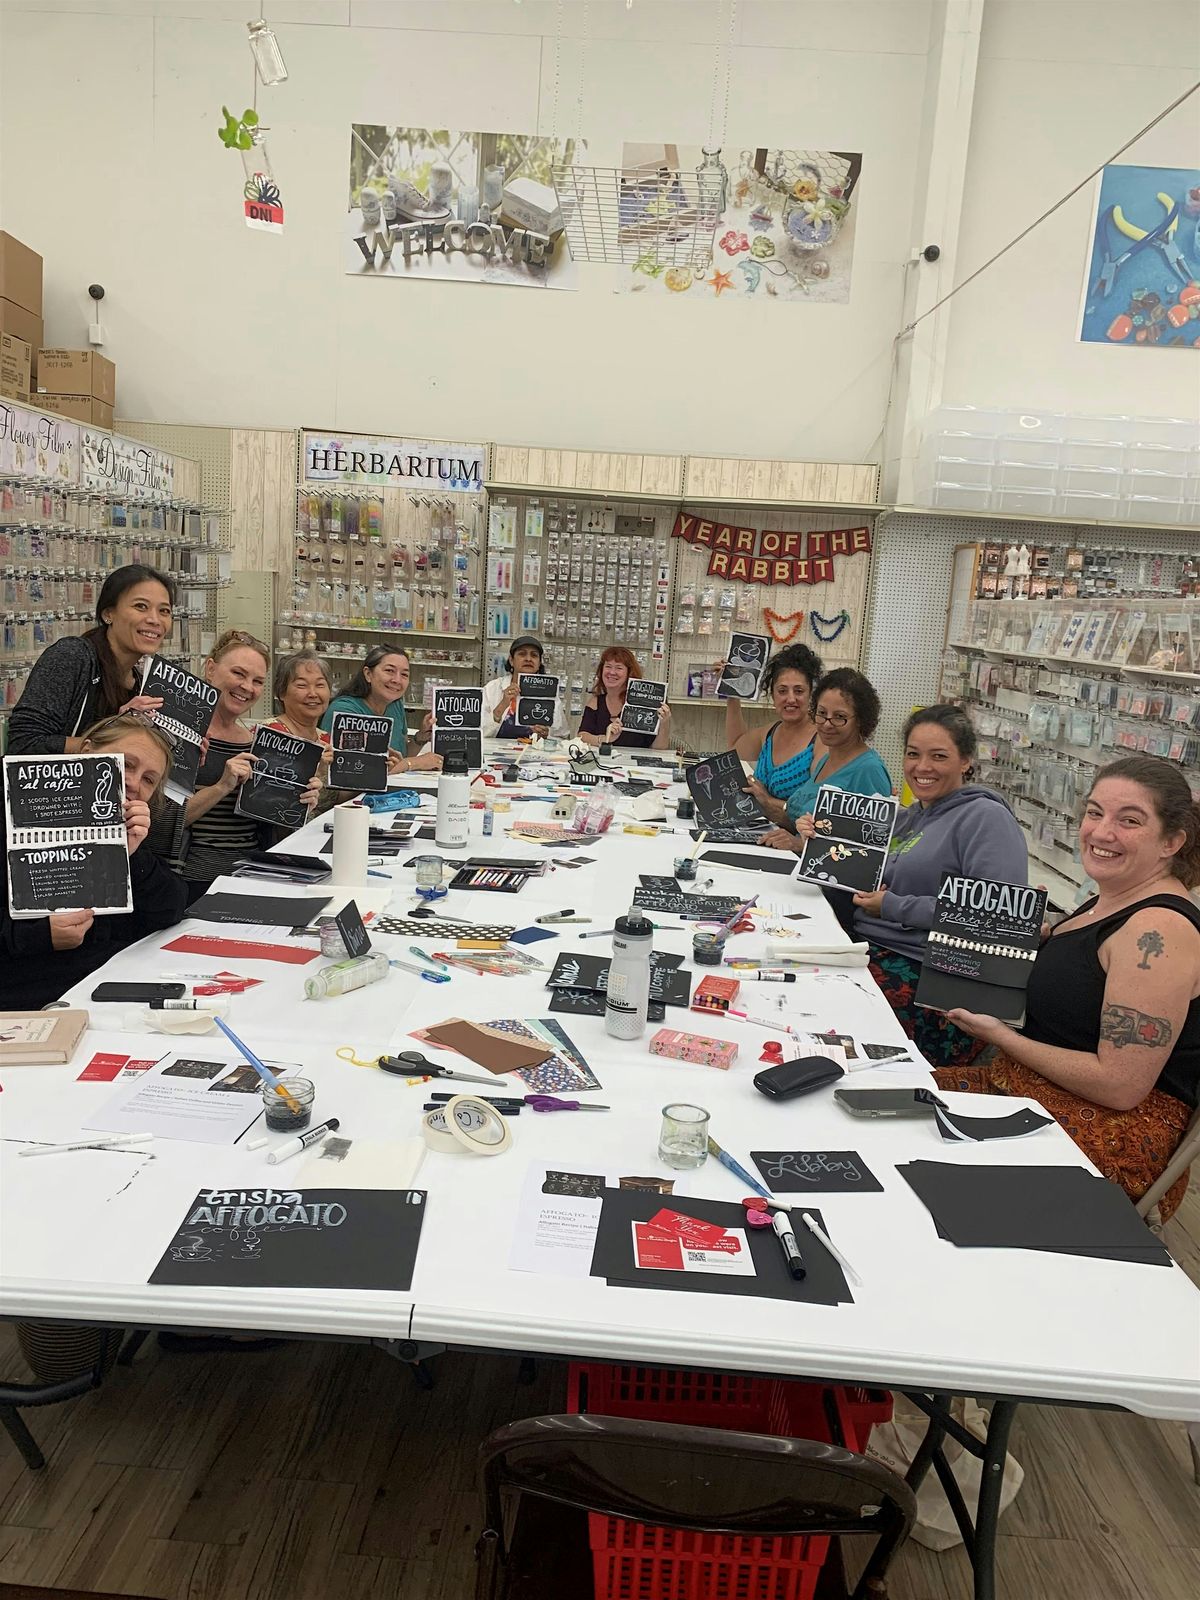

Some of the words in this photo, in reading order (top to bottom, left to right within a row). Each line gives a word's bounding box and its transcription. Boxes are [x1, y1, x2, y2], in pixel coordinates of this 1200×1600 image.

[250, 205, 273, 223] DNI
[352, 218, 554, 267] WELCOME
[0, 404, 37, 449] Flower
[38, 417, 66, 455] Film
[98, 437, 136, 495] Design
[136, 449, 161, 490] Film
[309, 448, 481, 482] HERBARIUM
[679, 515, 753, 550] YEAR
[763, 533, 798, 552] OF
[811, 529, 867, 552] THE
[712, 554, 830, 580] RABBIT
[153, 660, 218, 706] AFFOGATO
[437, 696, 480, 713] AFFOGATO
[338, 717, 389, 734] AFFOGATO
[257, 731, 306, 755] AFFOGATO
[18, 762, 84, 780] AFFOGATO
[716, 754, 737, 773] ICE
[22, 779, 39, 790] al
[818, 790, 890, 822] AFFOGATO
[24, 847, 87, 865] TOPPINGS
[938, 875, 1038, 920] AFFOGATO
[760, 1154, 862, 1181] Libby
[185, 1202, 348, 1227] AFFOGATO
[671, 1214, 711, 1232] Thank
